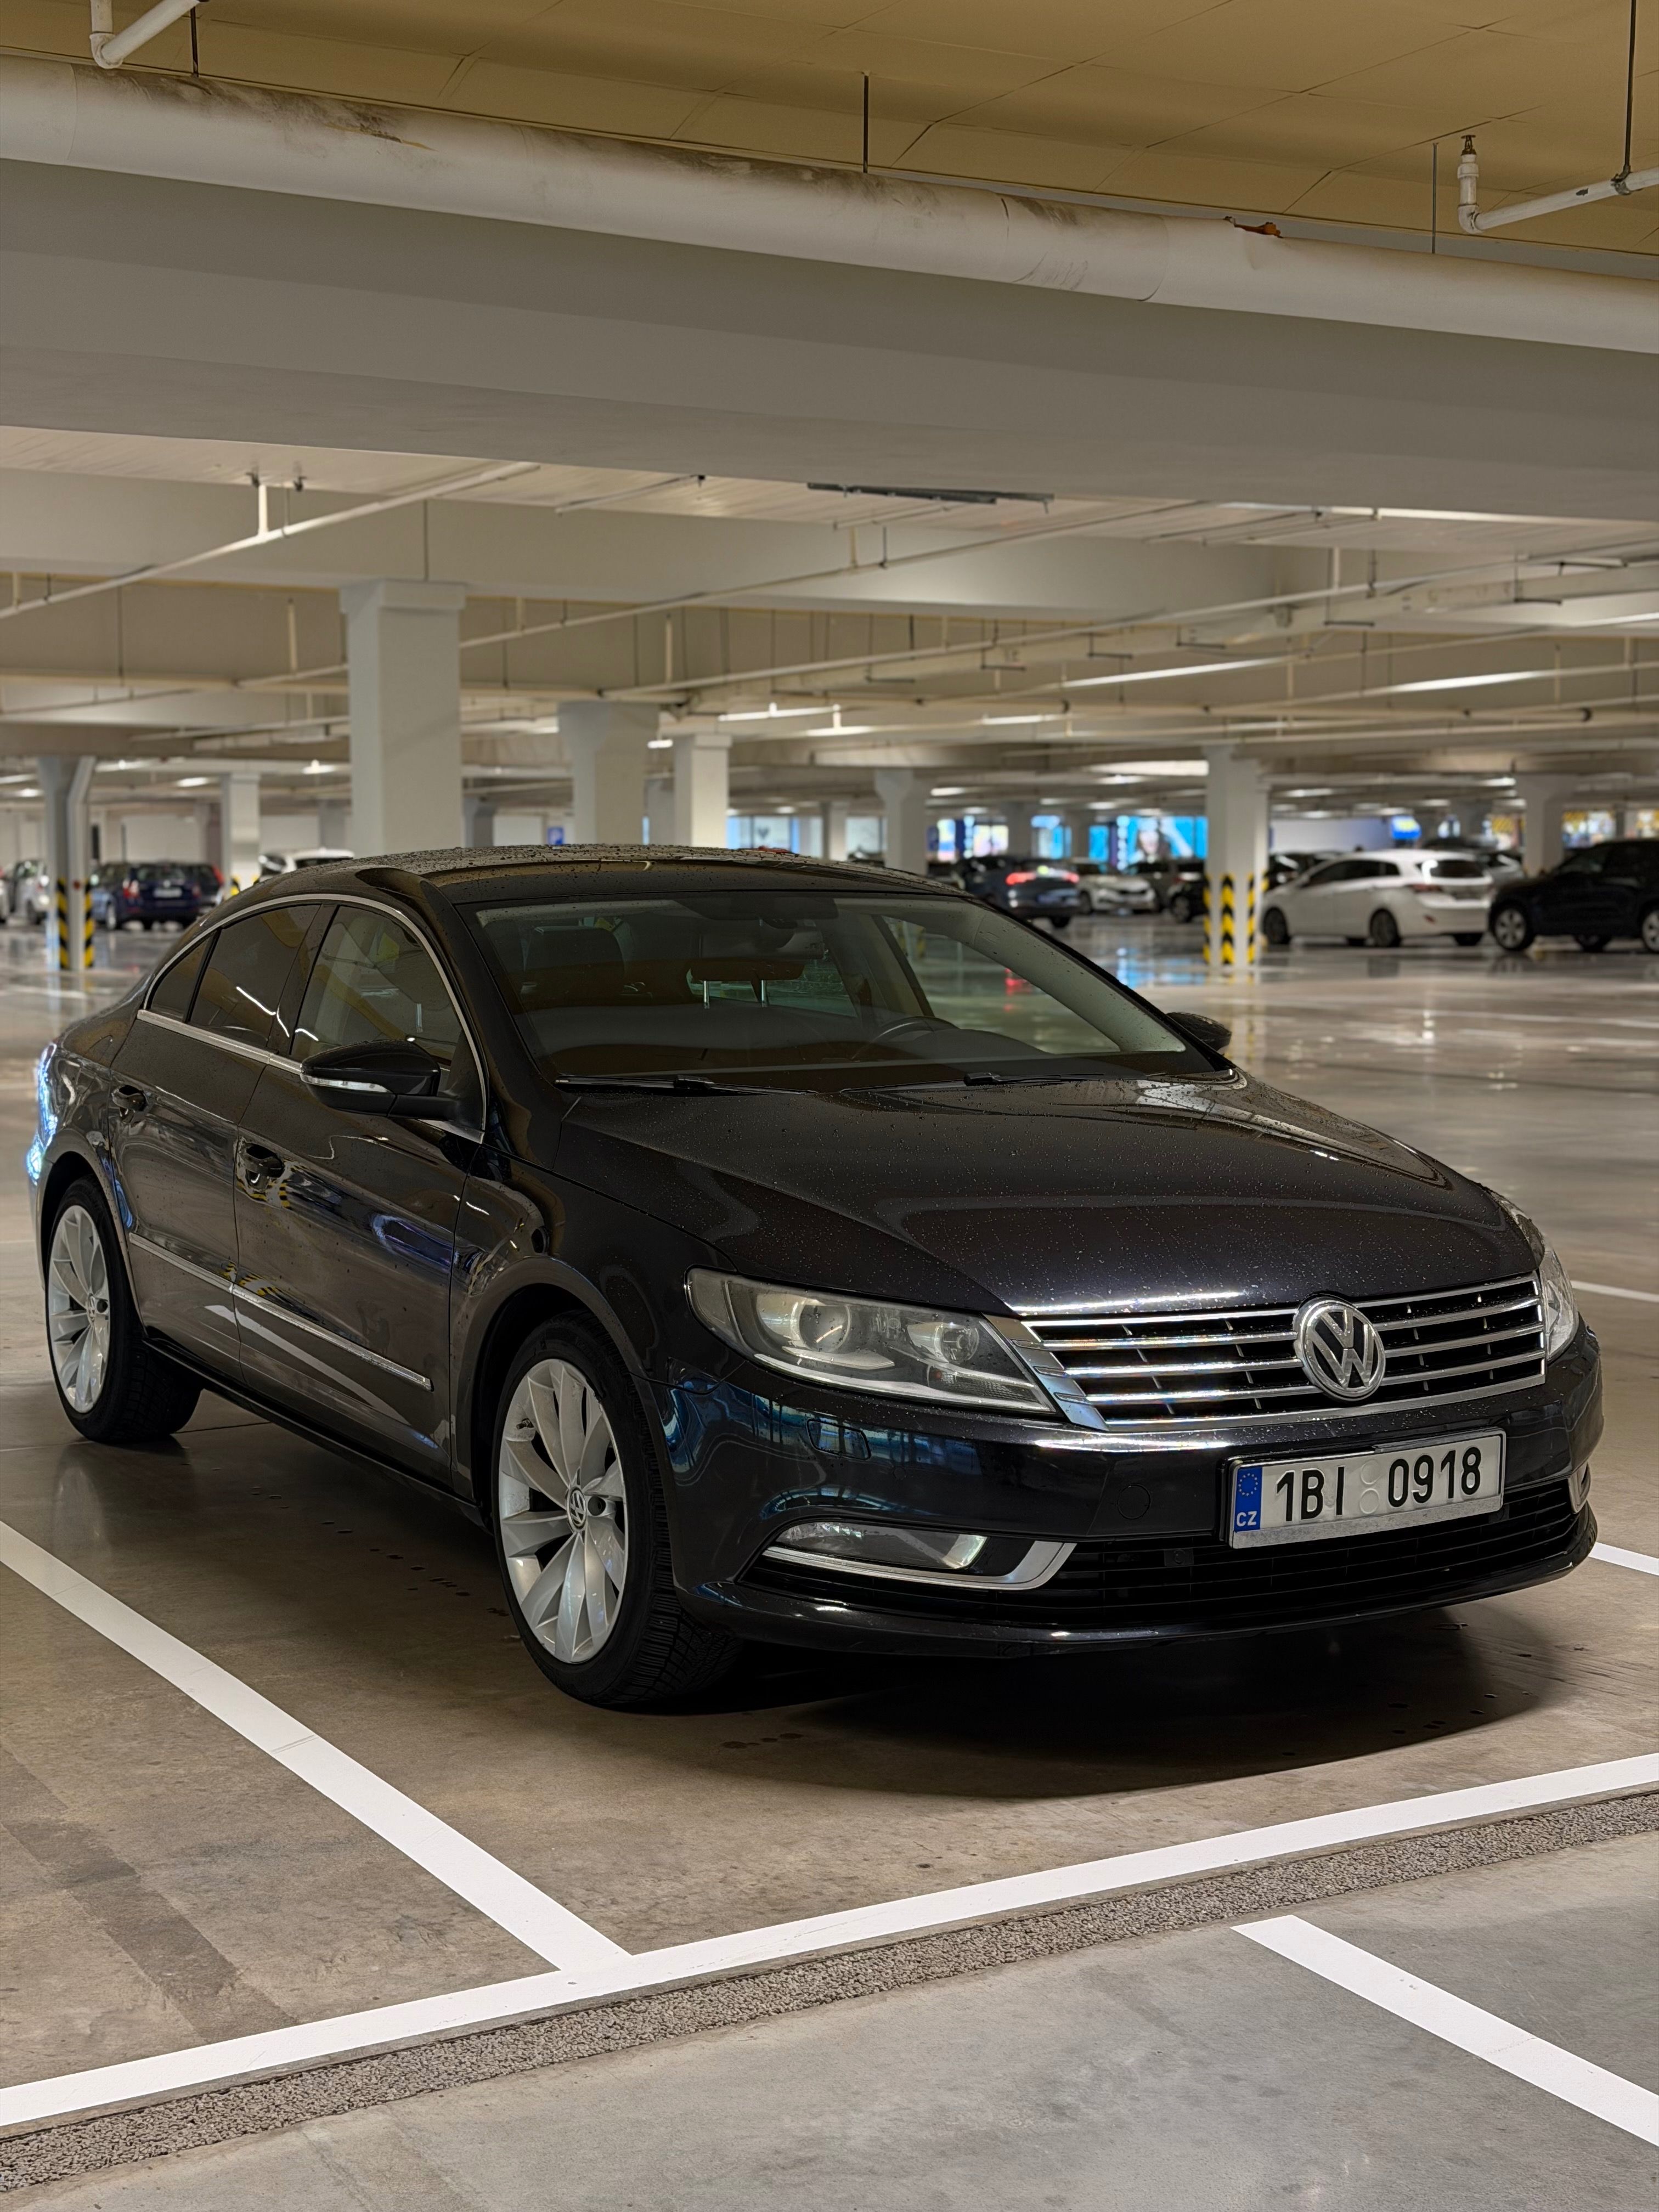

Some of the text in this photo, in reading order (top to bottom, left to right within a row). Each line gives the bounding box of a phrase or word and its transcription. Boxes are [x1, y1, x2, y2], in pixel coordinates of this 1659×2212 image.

[1305, 1304, 1377, 1391] VW
[1237, 1511, 1257, 1527] CZ
[1276, 1447, 1482, 1522] 1BI 0918
